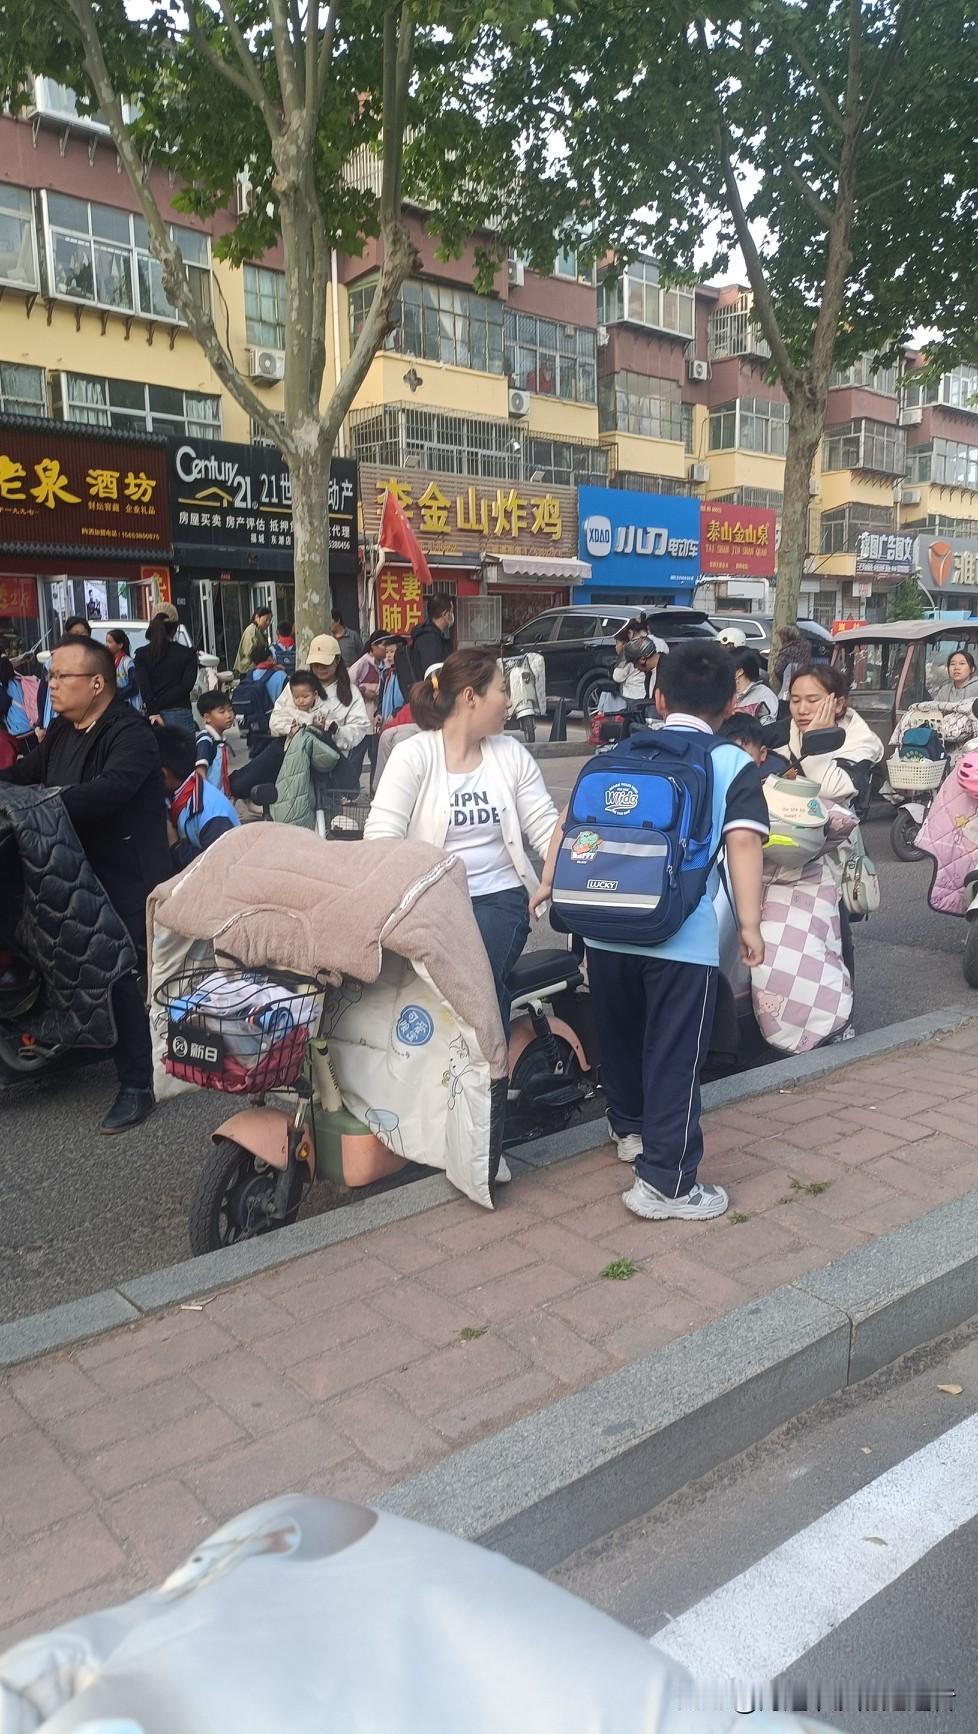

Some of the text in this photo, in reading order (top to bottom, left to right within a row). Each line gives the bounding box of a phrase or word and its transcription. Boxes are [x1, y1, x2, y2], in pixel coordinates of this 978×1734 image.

[176, 445, 239, 486] Century
[260, 473, 353, 511] 21世动产
[179, 511, 222, 527] 房屋买卖
[226, 516, 265, 531] 房产评估
[589, 528, 610, 543] XDAO
[616, 525, 699, 557] 小刀 电动车
[706, 520, 770, 546] 泰山金山泉
[380, 571, 421, 601] 夫妻
[382, 604, 421, 633] 肺片
[450, 791, 489, 807] IPN
[449, 807, 501, 826] DIDE
[590, 880, 616, 889] LUCKY
[190, 1042, 218, 1063] 新日
